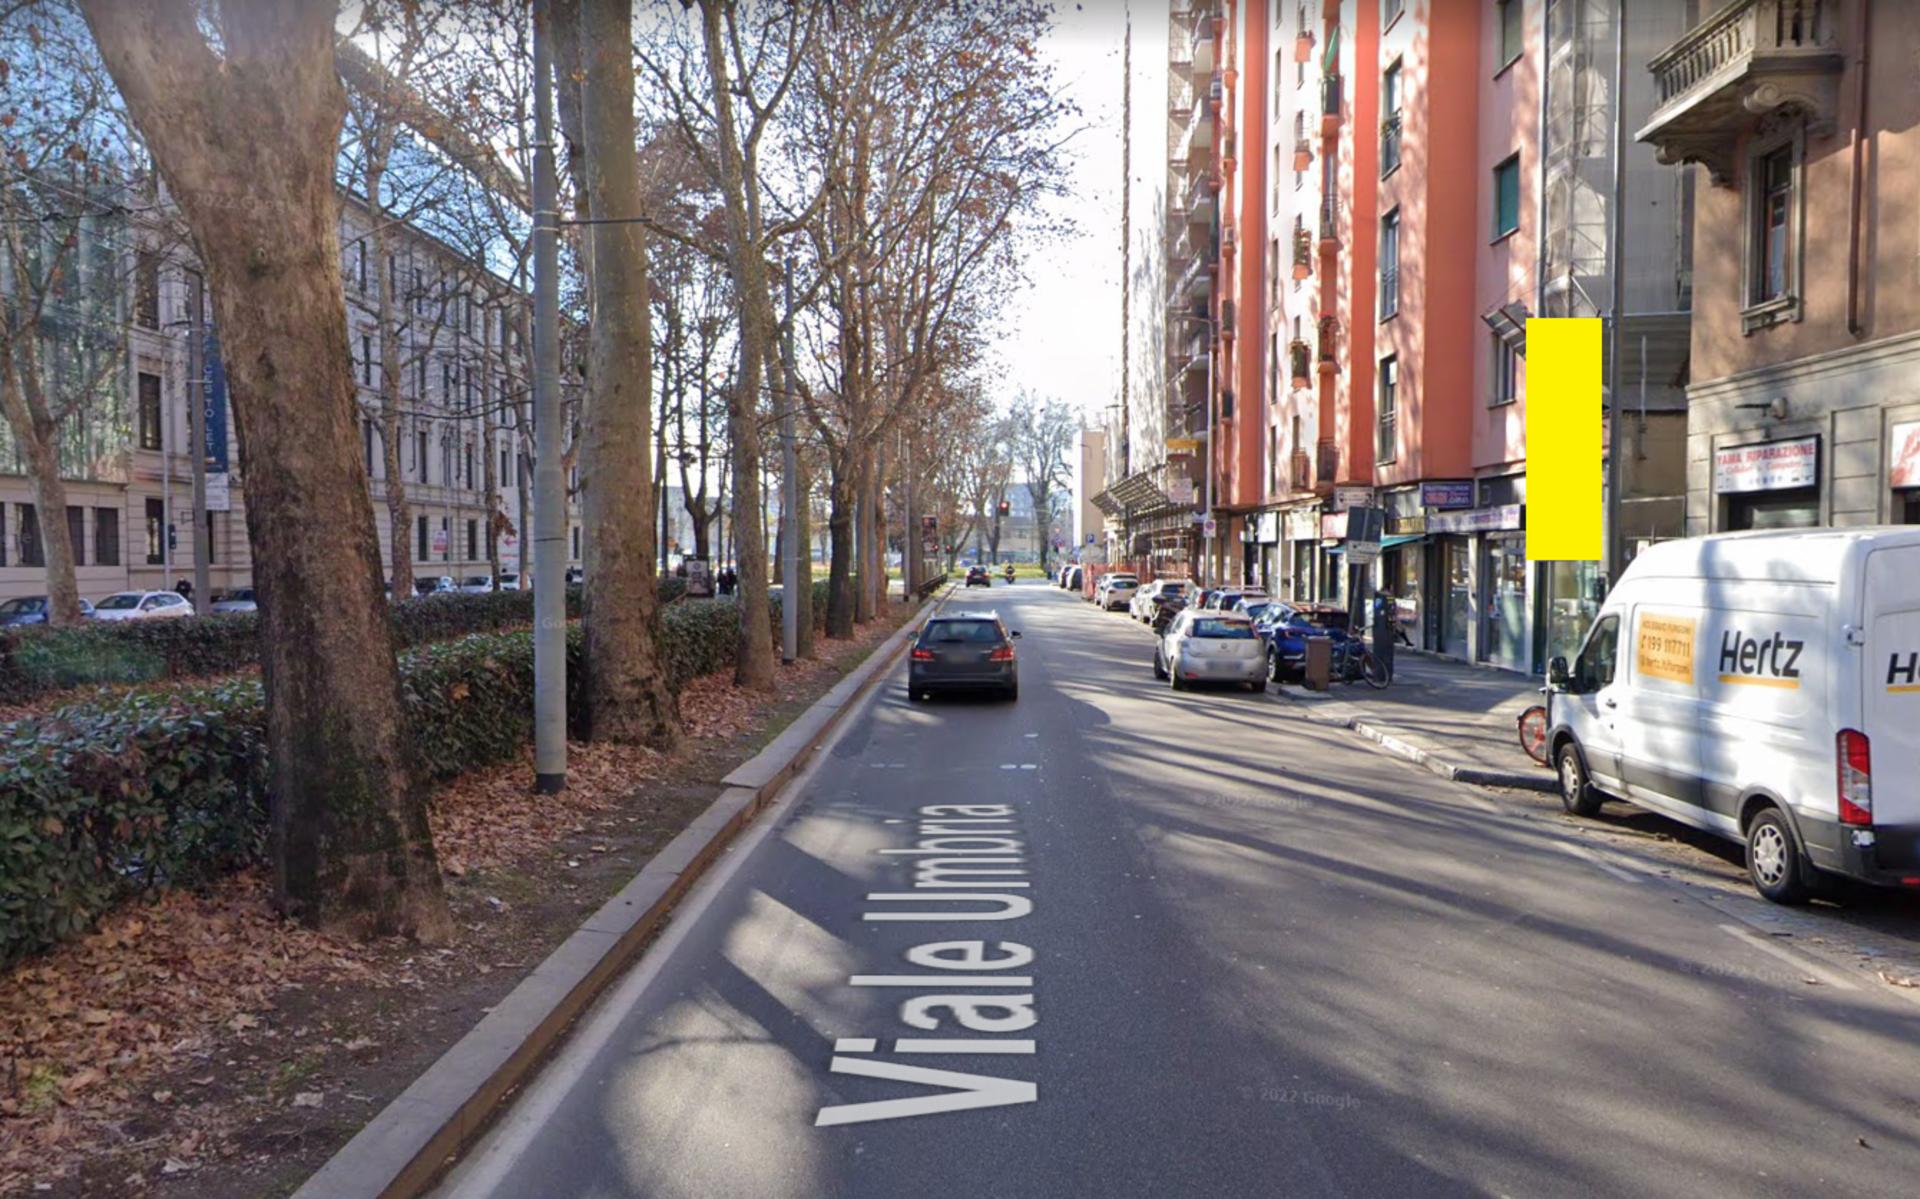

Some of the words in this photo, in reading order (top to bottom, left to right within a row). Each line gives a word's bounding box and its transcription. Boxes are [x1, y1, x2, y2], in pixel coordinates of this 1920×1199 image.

[204, 399, 215, 418] TO
[205, 423, 215, 451] LET
[1746, 443, 1814, 463] RIPARAZIONE
[1718, 630, 1804, 678] Hertz
[1886, 652, 1920, 684] H
